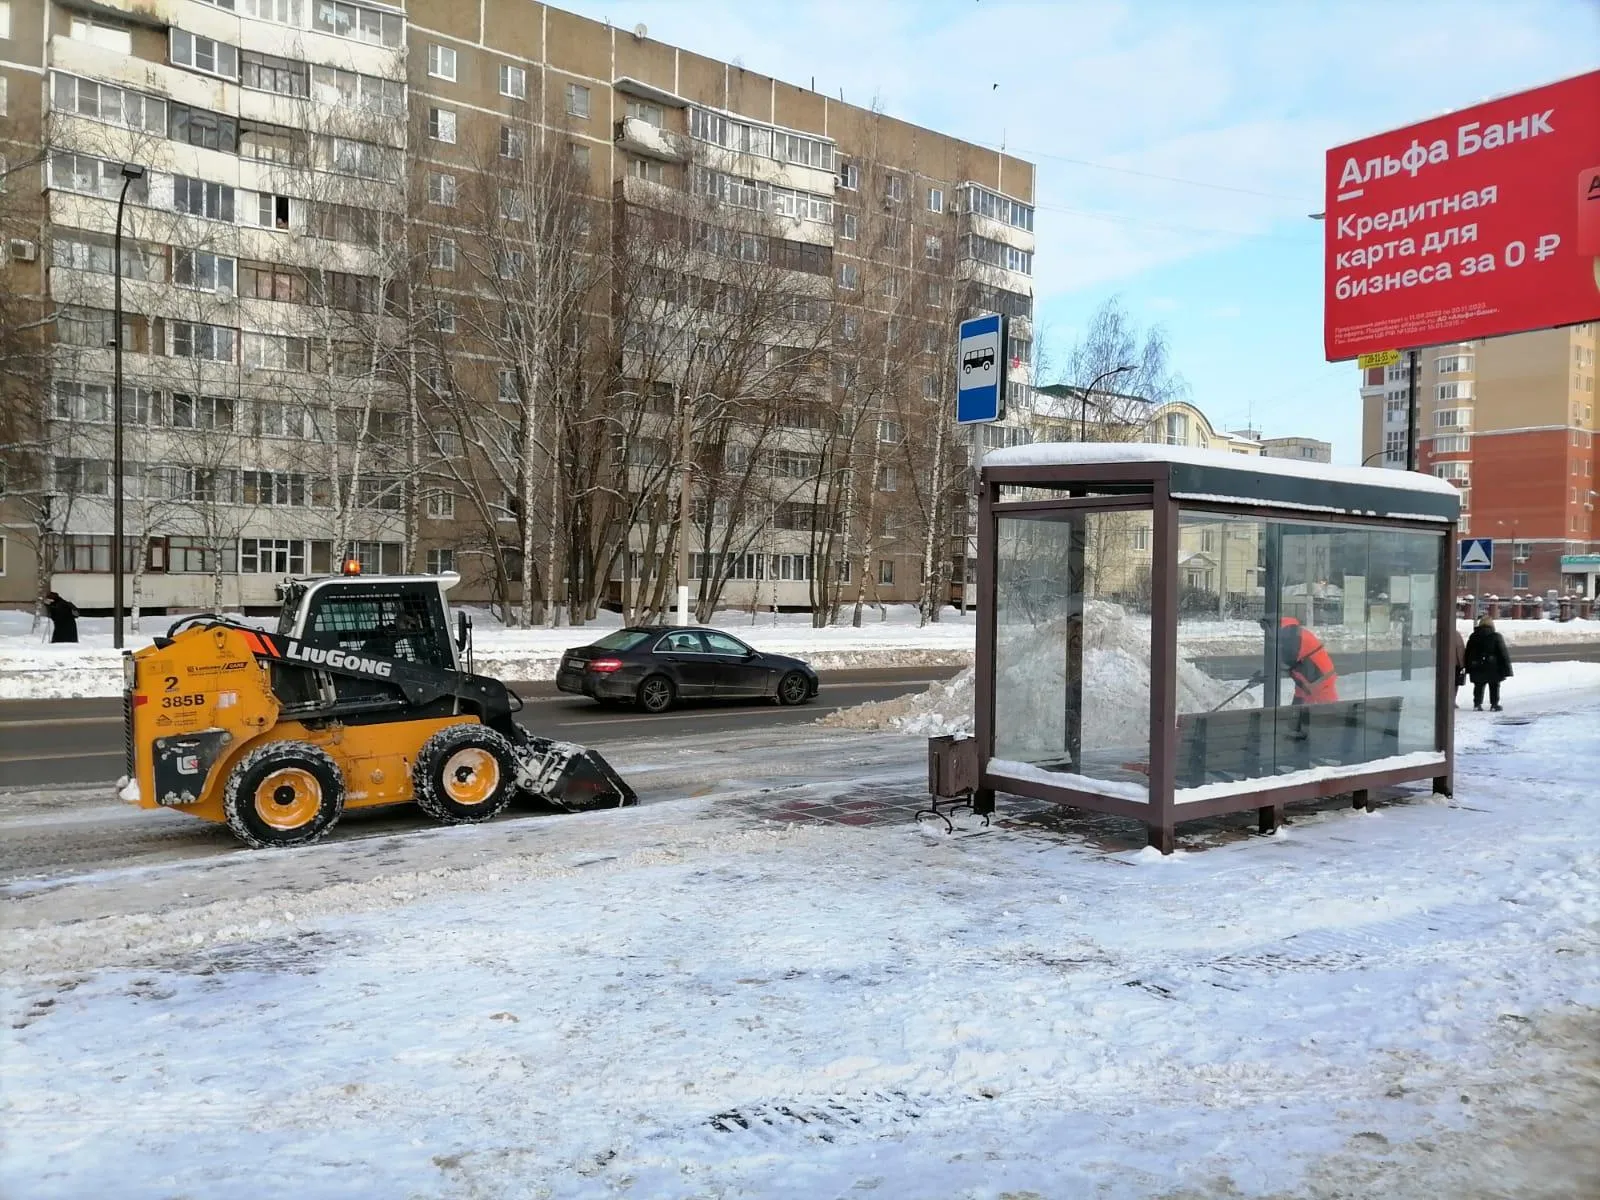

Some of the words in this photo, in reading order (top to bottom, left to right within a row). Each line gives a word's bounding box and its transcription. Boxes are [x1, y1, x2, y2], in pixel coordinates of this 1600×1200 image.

[1338, 139, 1449, 189] Альфа
[1457, 108, 1555, 157] Банк
[1337, 185, 1498, 241] Кредитная
[1335, 261, 1453, 300] бизнеса
[1459, 253, 1496, 277] за
[1505, 240, 1526, 268] 0
[1336, 237, 1416, 270] карта
[1421, 223, 1478, 257] для
[286, 641, 392, 677] LIUGONG
[162, 694, 205, 708] 385B
[164, 676, 179, 690] 2
